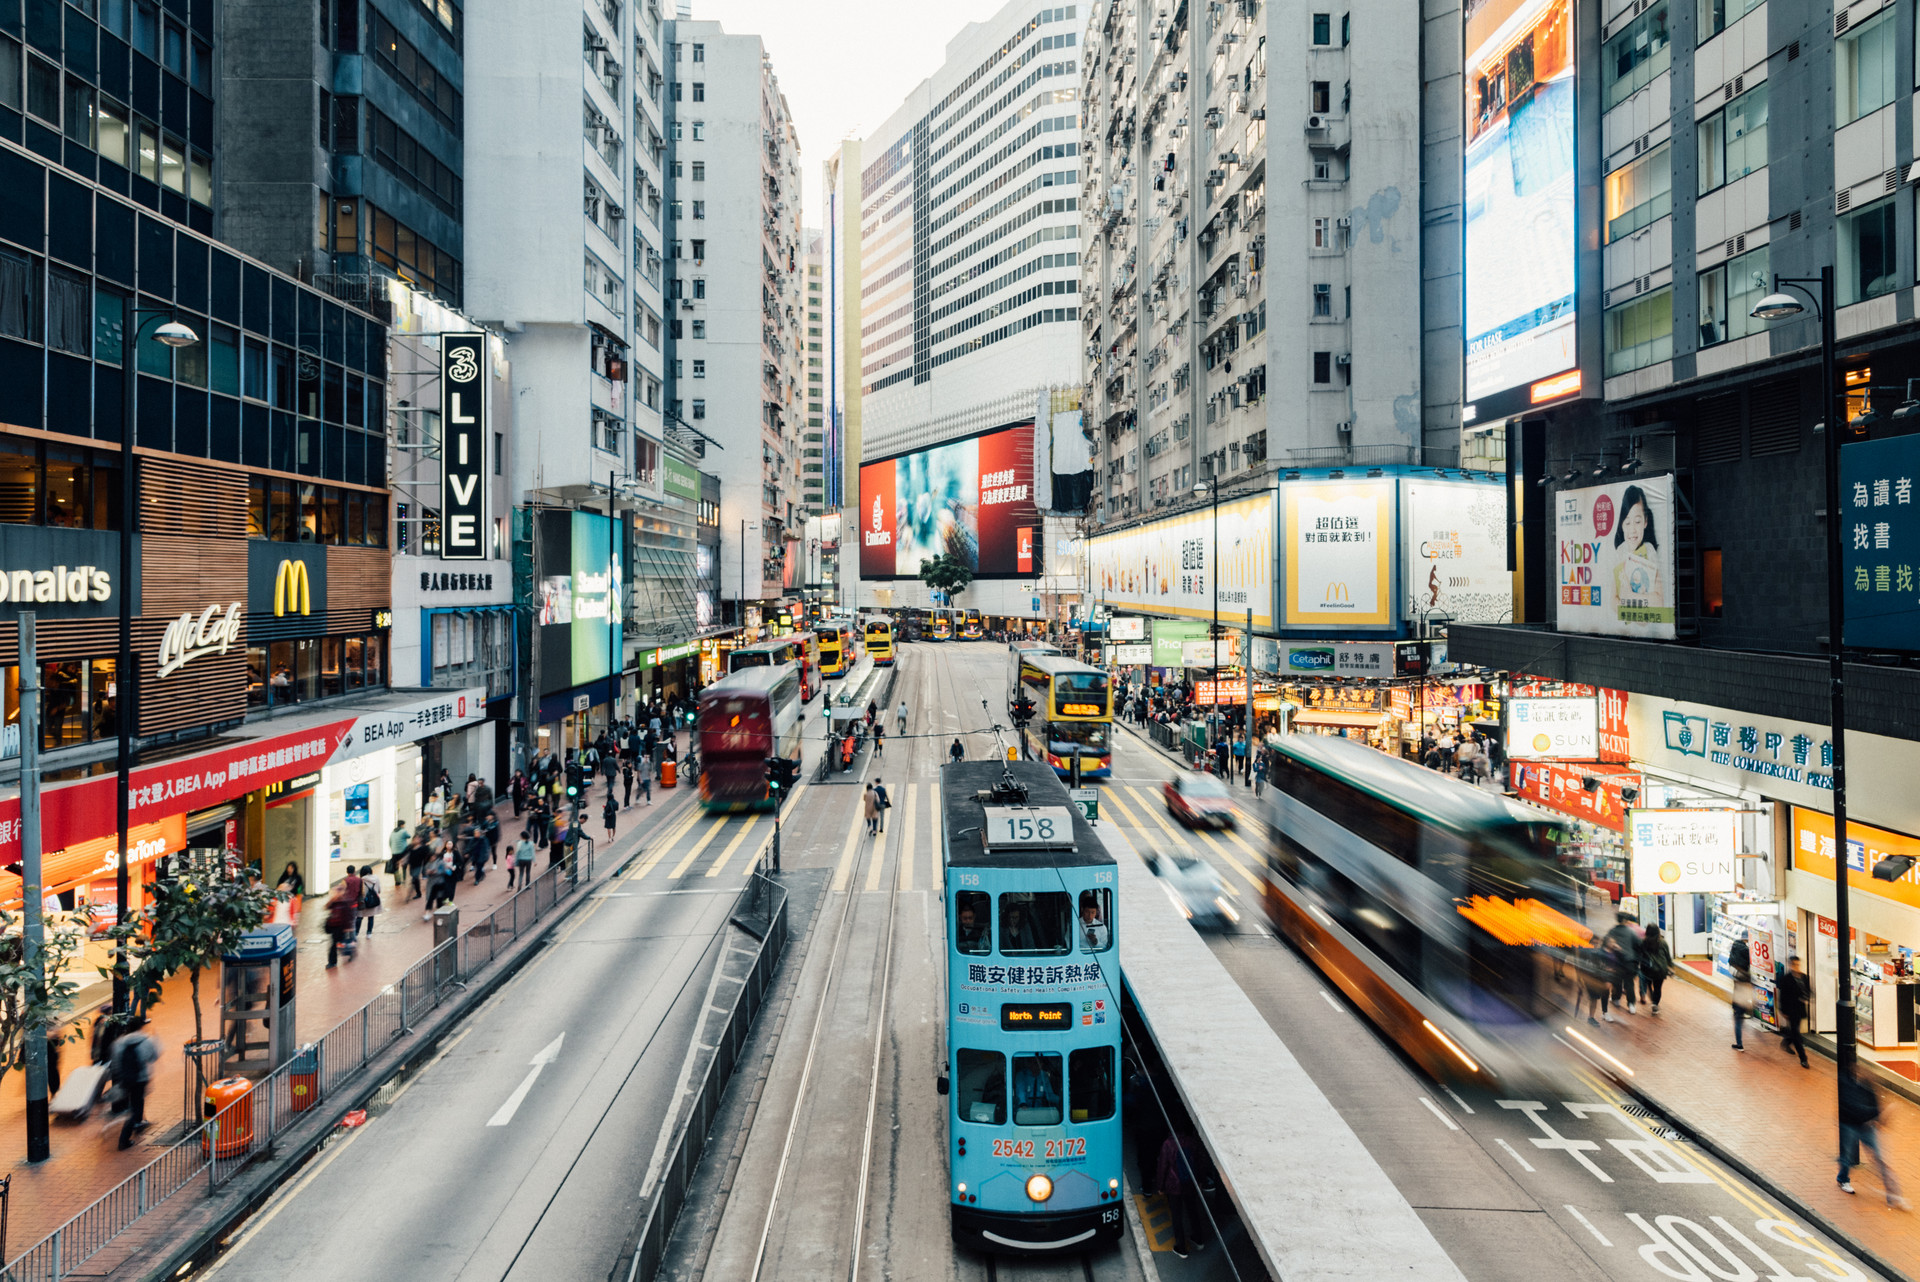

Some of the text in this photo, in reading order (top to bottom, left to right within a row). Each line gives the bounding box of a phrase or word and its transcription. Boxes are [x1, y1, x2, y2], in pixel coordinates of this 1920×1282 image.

[1470, 340, 1483, 354] FOR
[1484, 330, 1502, 348] LEASE
[449, 392, 478, 547] LIVE
[1853, 477, 1912, 508] 為讀者
[1316, 516, 1358, 530] 超值選
[866, 530, 891, 546] Emirates
[1853, 522, 1891, 550] 找書
[1430, 550, 1453, 563] PLACE
[1561, 566, 1592, 584] LAND
[1854, 564, 1920, 592] 為書找
[1562, 588, 1600, 604] 兒童天地
[158, 602, 241, 669] McCafé
[1292, 654, 1331, 666] Cetaphil
[1339, 652, 1380, 663] 舒特膚
[364, 725, 384, 743] BEA
[386, 721, 404, 739] App
[1555, 735, 1591, 746] SUN
[1710, 751, 1732, 766] THE
[1733, 756, 1803, 783] COMMERCIAL
[203, 771, 227, 789] App
[1007, 818, 1055, 840] 158
[1094, 871, 1112, 883] 158
[1686, 862, 1730, 876] SUN
[959, 874, 980, 886] 158
[1820, 921, 1836, 936] $400
[1754, 940, 1769, 960] 98
[968, 963, 1101, 985] 職安健投訴熱線
[960, 984, 998, 992] Occupational
[1009, 1011, 1063, 1020] North Point
[992, 1137, 1087, 1158] 2542 2172
[1102, 1208, 1120, 1224] 158
